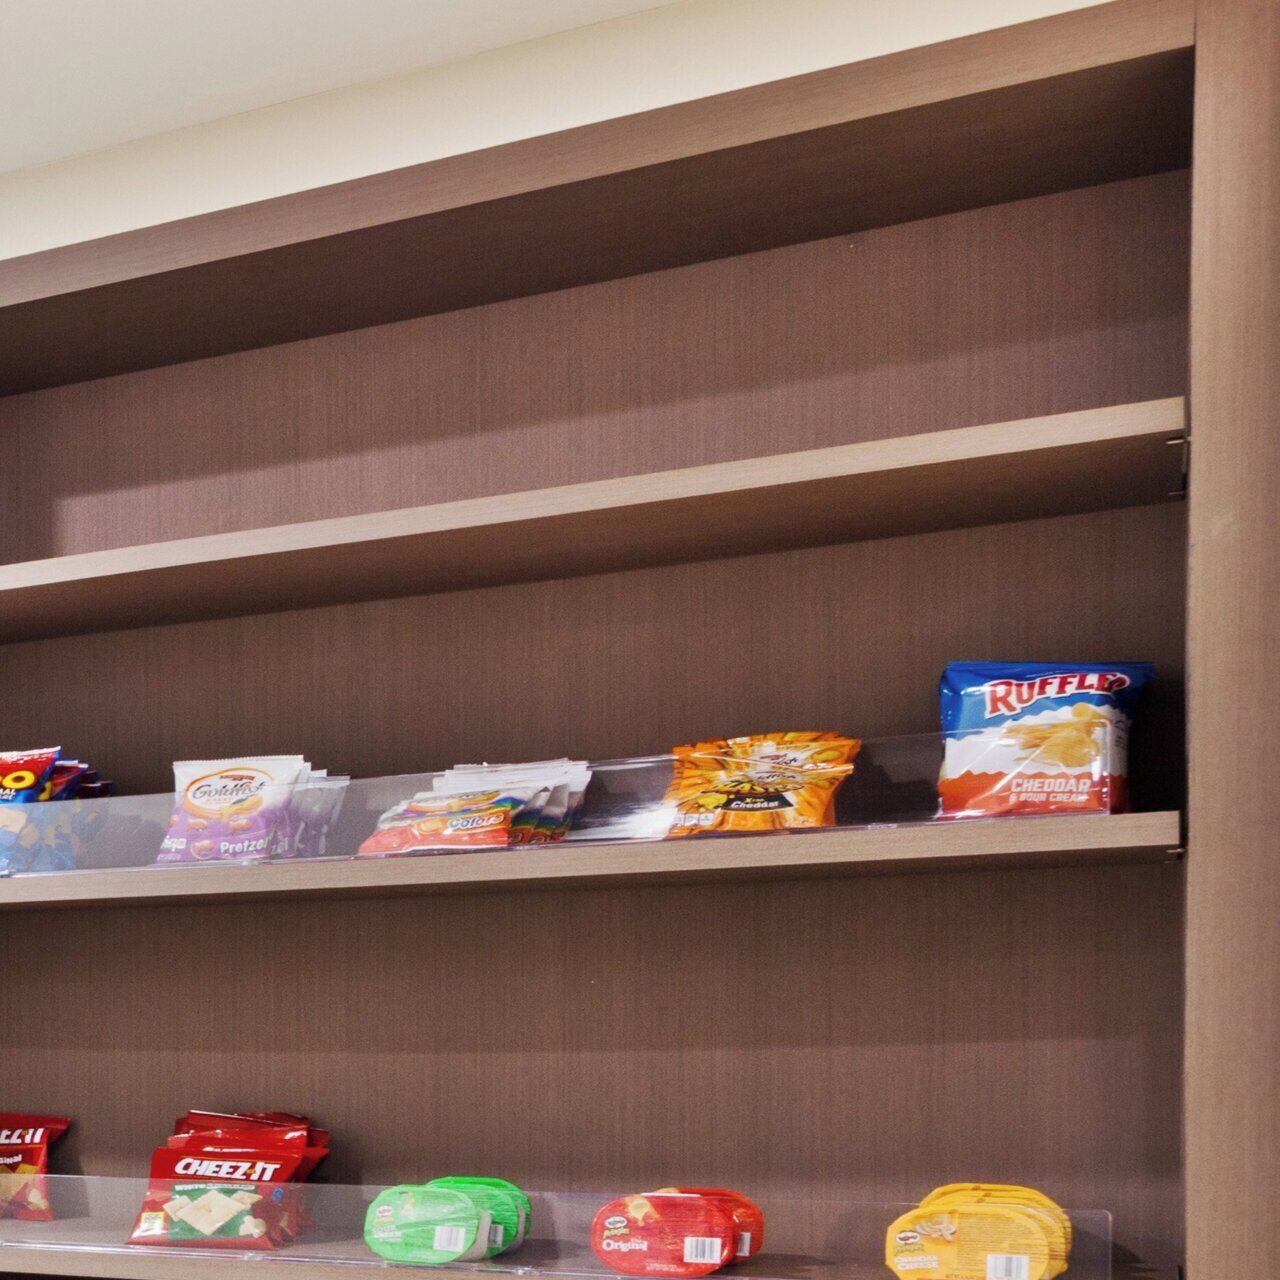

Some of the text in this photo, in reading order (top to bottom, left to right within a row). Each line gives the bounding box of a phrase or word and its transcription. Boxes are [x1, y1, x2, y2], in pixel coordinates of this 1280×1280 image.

[192, 781, 266, 800] Goldfish
[1011, 778, 1091, 792] CHEDDAR
[1019, 793, 1048, 801] SOUR
[730, 799, 780, 810] Cheddar
[446, 811, 505, 830] Colors
[220, 836, 269, 854] Pretzel
[602, 1239, 648, 1252] Original
